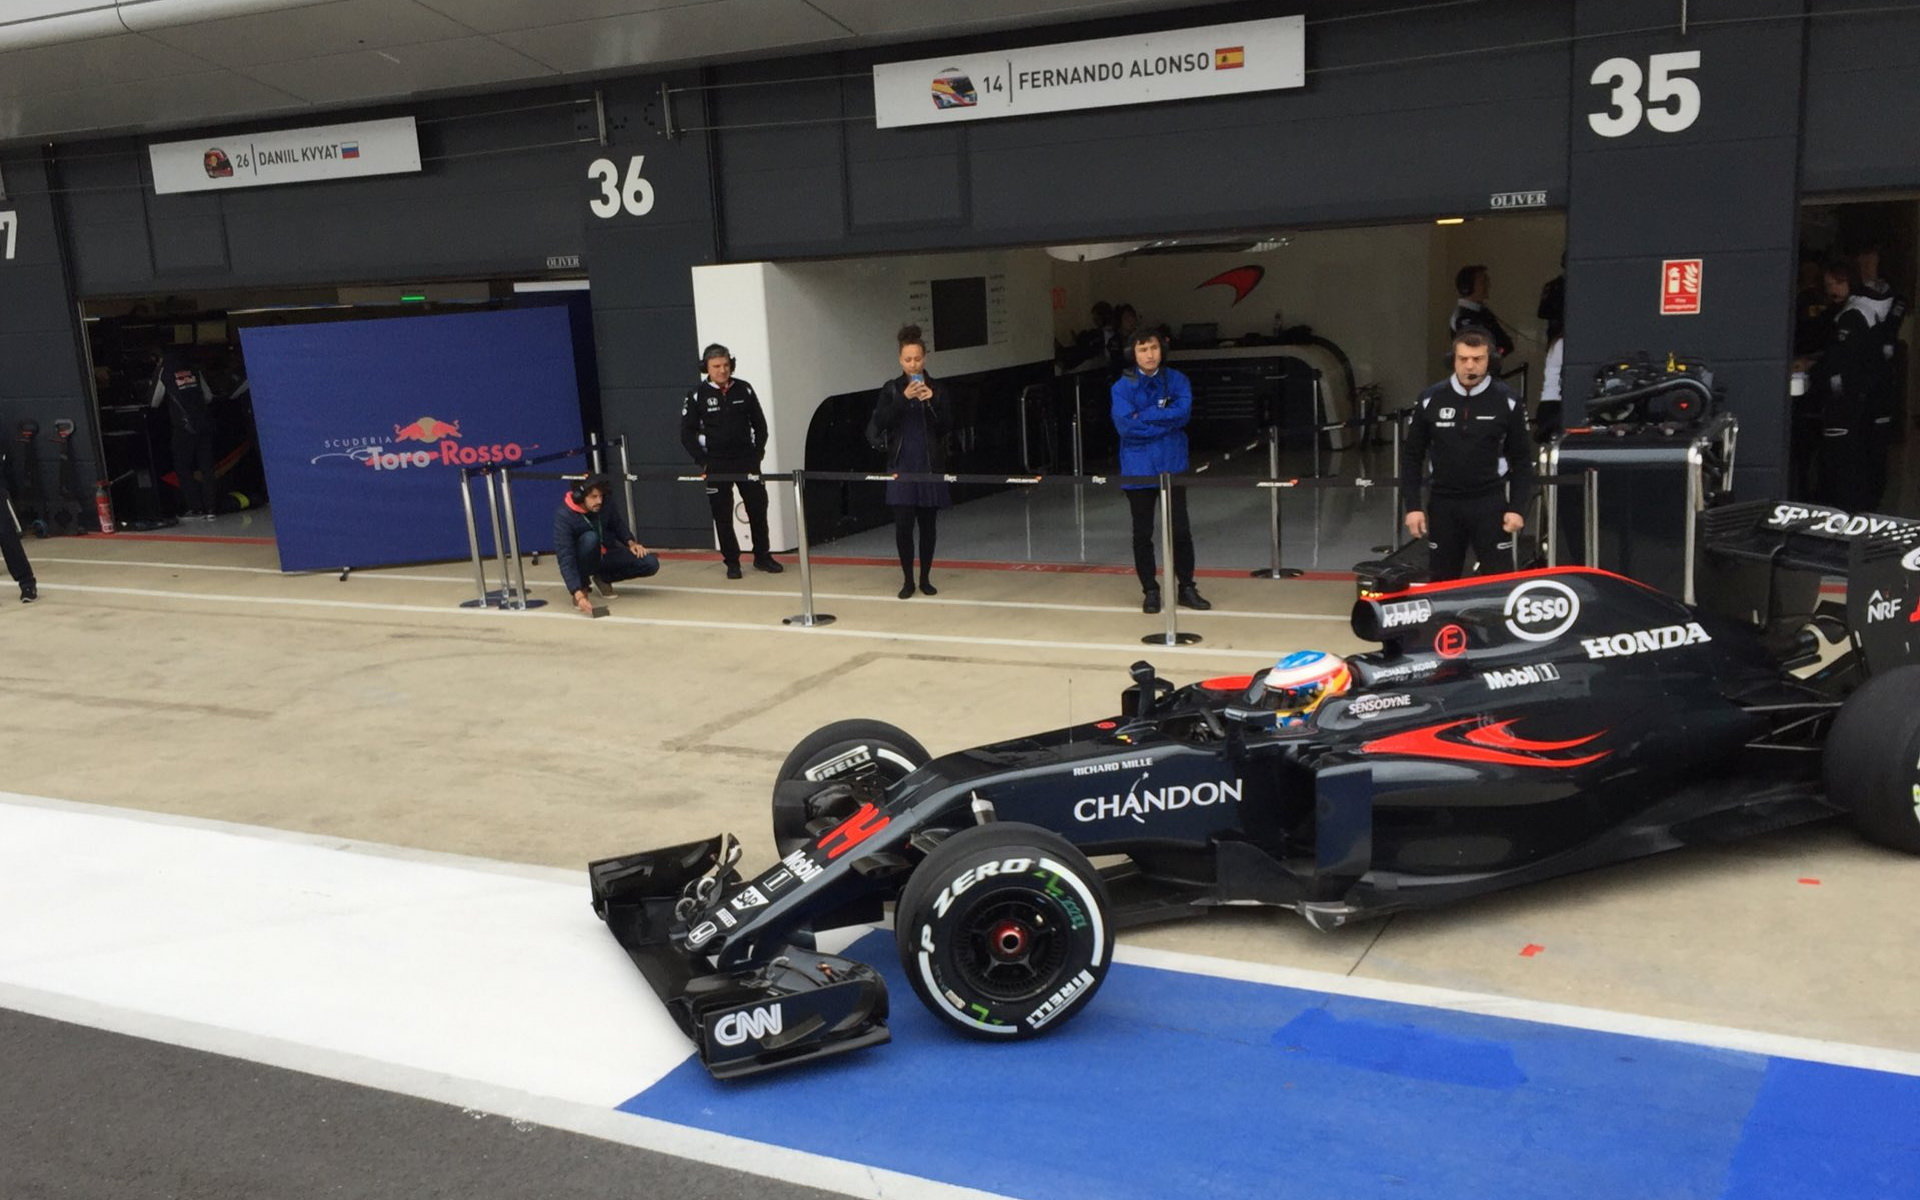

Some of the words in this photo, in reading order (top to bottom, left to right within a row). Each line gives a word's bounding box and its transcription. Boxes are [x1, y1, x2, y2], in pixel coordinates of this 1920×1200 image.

[983, 74, 1003, 94] 14
[1018, 62, 1124, 90] FERNANDO
[1129, 52, 1210, 79] ALONSO
[1588, 50, 1701, 137] 35
[236, 154, 250, 168] 26
[259, 151, 300, 166] DANIIL
[301, 144, 339, 162] KVYAT
[588, 155, 655, 219] 36
[1490, 191, 1547, 209] OLIVER
[546, 256, 580, 268] OLIVER
[324, 436, 393, 449] SCUDERIA
[366, 446, 431, 471] Toro
[440, 440, 523, 466] Rosso
[1382, 607, 1430, 628] KPMG
[1515, 597, 1570, 624] Esso
[1867, 598, 1902, 623] NRF
[1580, 622, 1712, 659] HONDA
[1483, 665, 1540, 690] Mobil
[1349, 694, 1411, 715] SENSODYNE
[805, 745, 871, 782] PIRELLI
[1073, 762, 1119, 776] RICHARD
[1122, 757, 1153, 769] MILLE
[1074, 779, 1243, 822] CHANDON
[782, 849, 825, 883] Mobil
[736, 889, 758, 908] SAP
[921, 923, 935, 953] P
[933, 858, 1032, 918] ZERO
[1026, 969, 1096, 1029] PIRELLI
[714, 1003, 783, 1046] CNN
